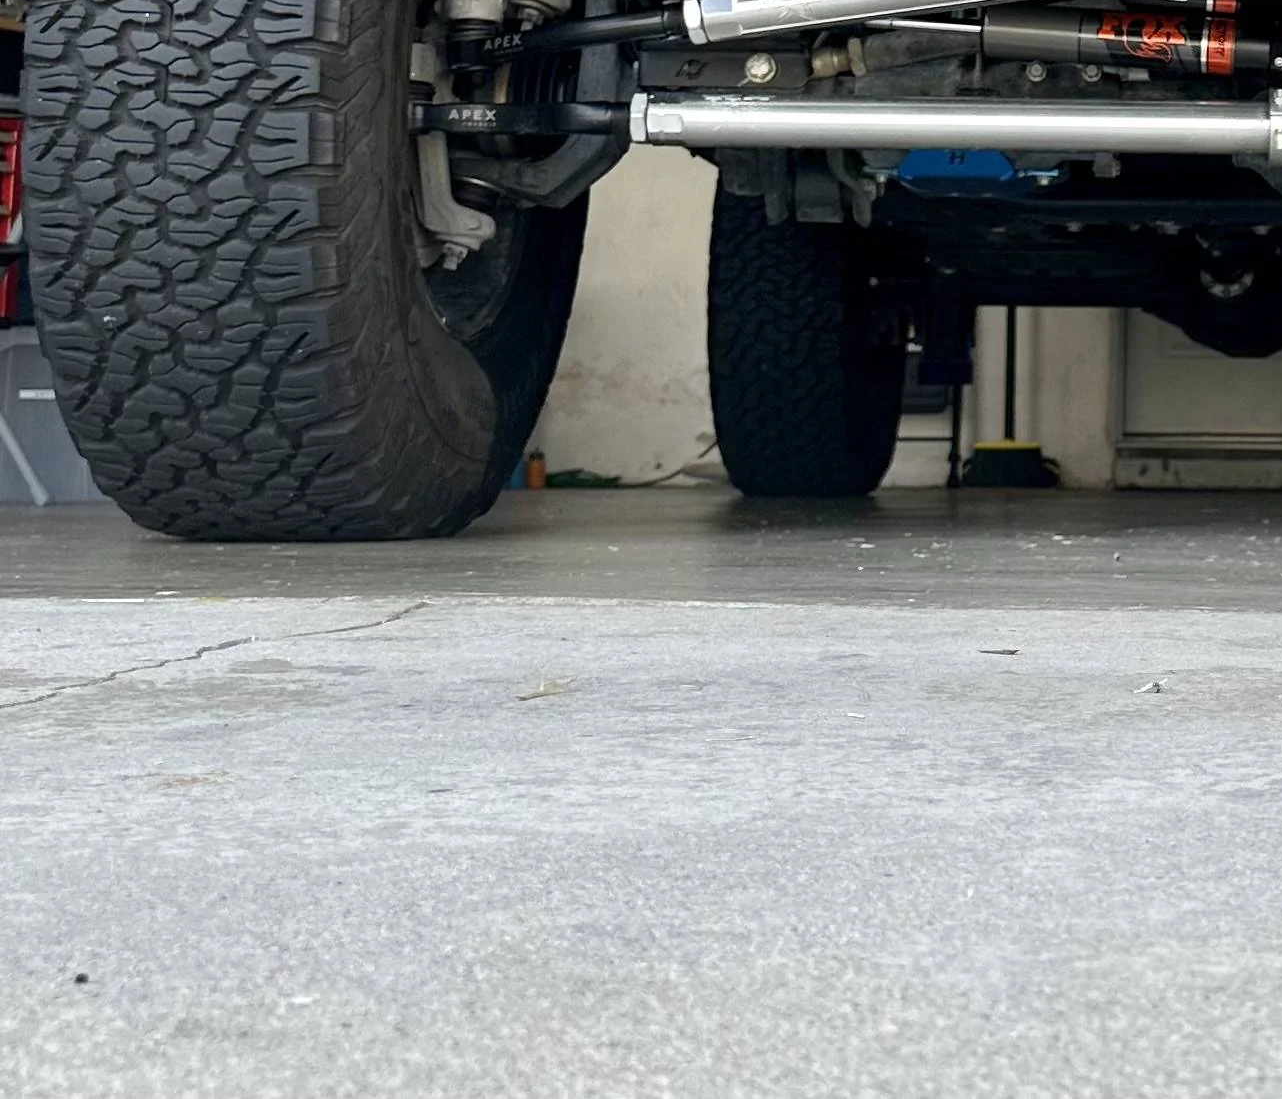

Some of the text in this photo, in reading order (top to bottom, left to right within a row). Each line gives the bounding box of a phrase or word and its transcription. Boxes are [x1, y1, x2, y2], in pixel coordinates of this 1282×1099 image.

[1097, 11, 1186, 47] FOX
[484, 33, 522, 51] APEX
[448, 108, 496, 121] APEX
